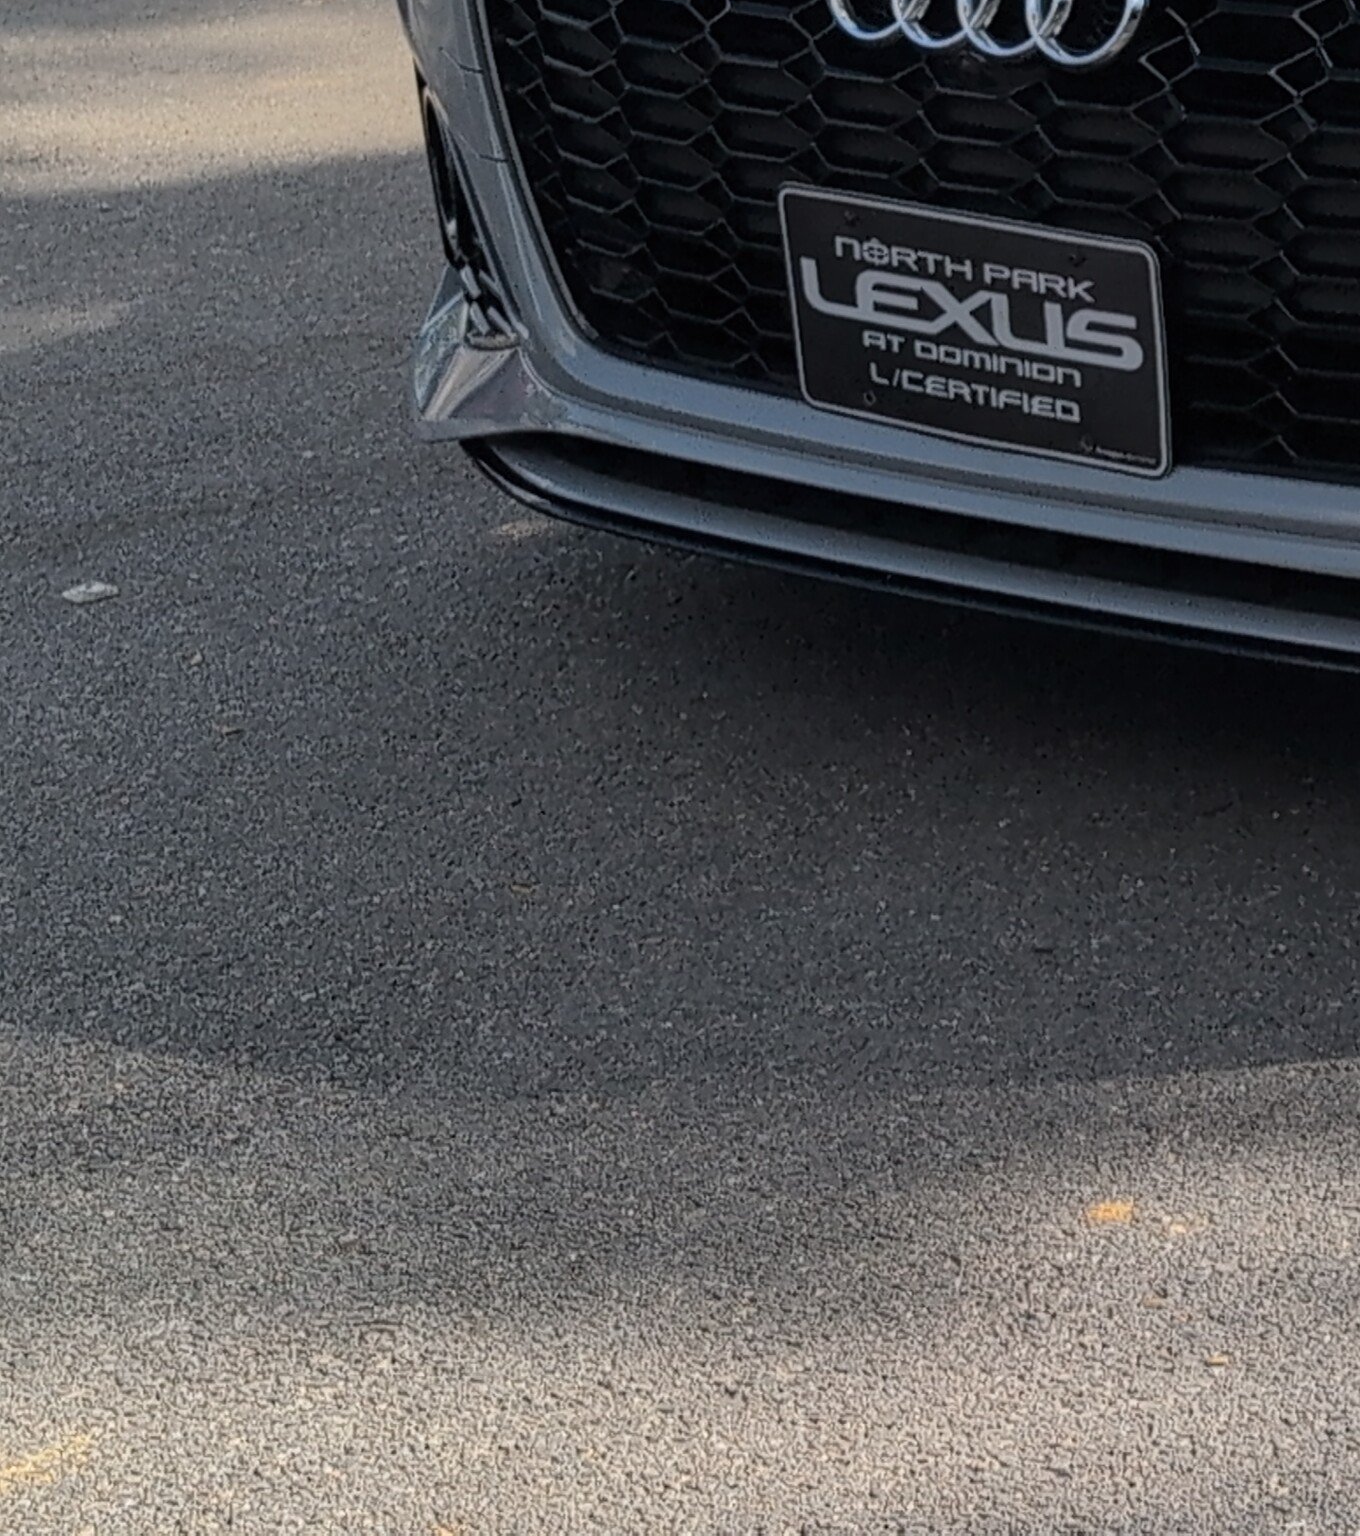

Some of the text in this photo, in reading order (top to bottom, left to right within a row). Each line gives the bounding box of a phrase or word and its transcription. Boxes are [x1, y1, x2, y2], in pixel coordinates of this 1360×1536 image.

[982, 262, 1096, 304] PARK
[799, 256, 1145, 372] LEXUS
[863, 330, 906, 354] AT
[869, 362, 1083, 424] L/CERTIFIED
